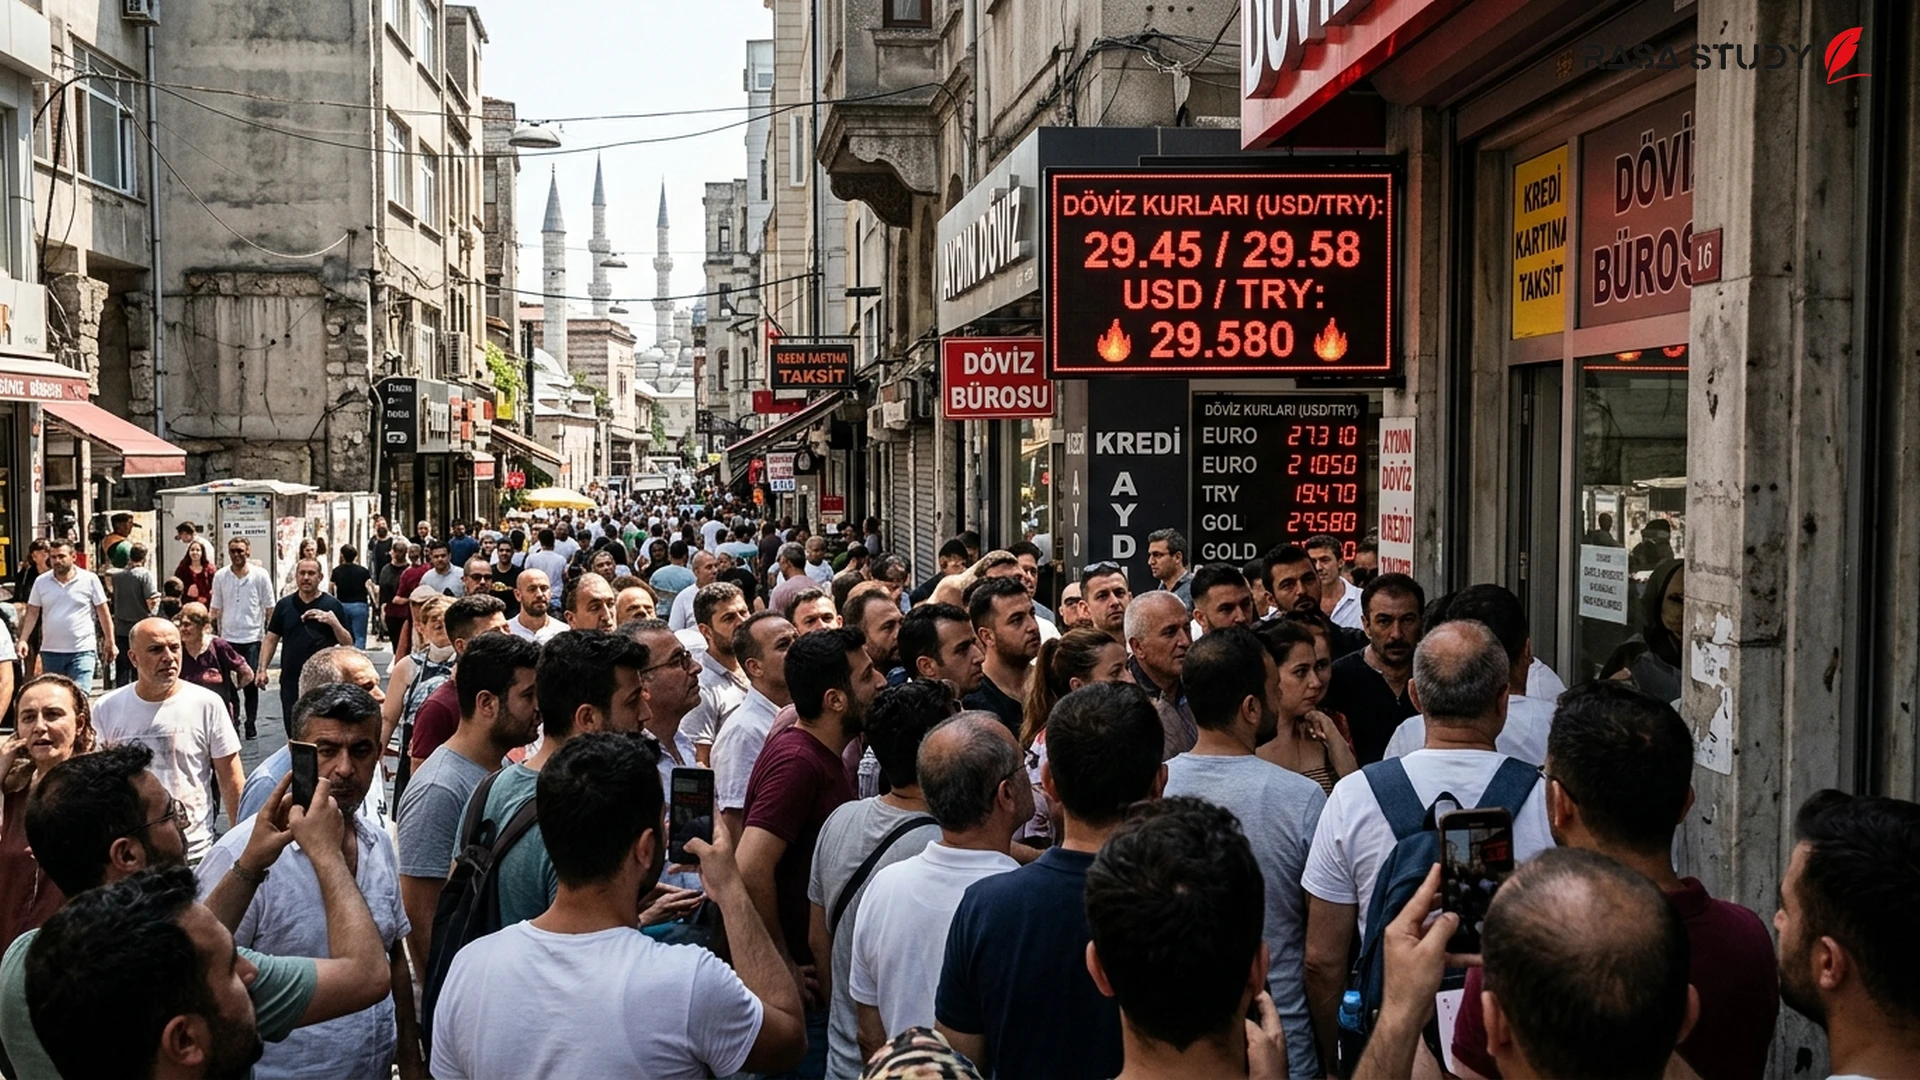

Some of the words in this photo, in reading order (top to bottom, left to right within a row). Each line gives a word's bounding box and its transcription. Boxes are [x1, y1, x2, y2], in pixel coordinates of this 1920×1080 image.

[1614, 111, 1695, 217] DÖVİ
[1523, 164, 1561, 214] KREDİ
[1062, 189, 1136, 216] DÖVİZ
[1143, 194, 1249, 216] KURLARI
[1256, 194, 1384, 220] (USD/TRY):
[1083, 230, 1202, 268] 29.45
[1215, 230, 1230, 268] /
[1242, 230, 1361, 269] 29.58
[1697, 241, 1713, 272] 16
[1123, 279, 1202, 310] USD
[1213, 279, 1226, 310] /
[1236, 279, 1324, 310] TRY:
[1519, 259, 1564, 302] TAKSİT
[1149, 320, 1295, 359] 29.580
[778, 365, 845, 383] TAKSİT
[963, 346, 1036, 376] DÖVİZ
[950, 381, 1048, 410] BÜROSU
[1204, 401, 1241, 416] DÖVİZ
[1243, 404, 1296, 416] KURLARI
[1095, 426, 1180, 455] KREDİ
[1202, 427, 1258, 444] EURO
[1202, 456, 1258, 473] EURO
[1202, 485, 1240, 502] TRY
[1202, 543, 1257, 560] GOLD
